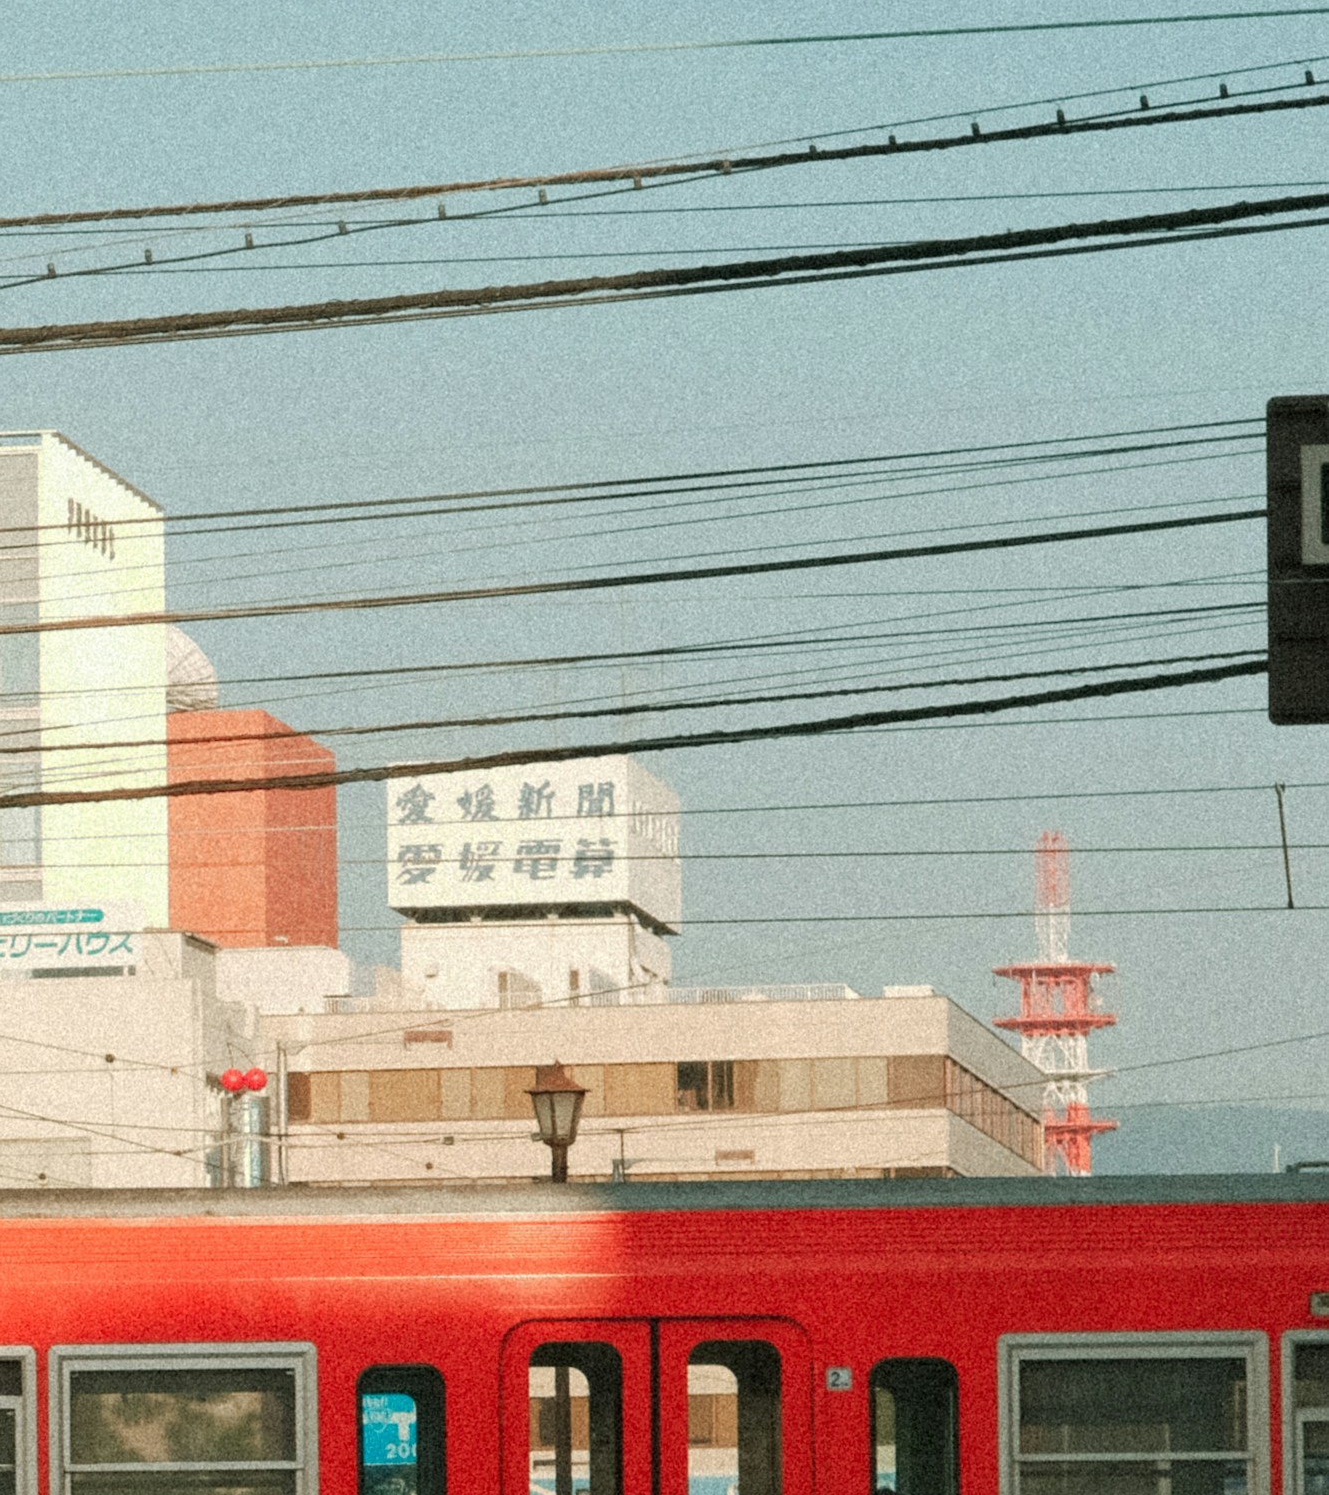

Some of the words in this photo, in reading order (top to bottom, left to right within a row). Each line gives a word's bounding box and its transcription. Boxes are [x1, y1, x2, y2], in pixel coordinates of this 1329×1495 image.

[395, 779, 616, 824] 愛媛新聞
[395, 837, 618, 886] 愛媛電算
